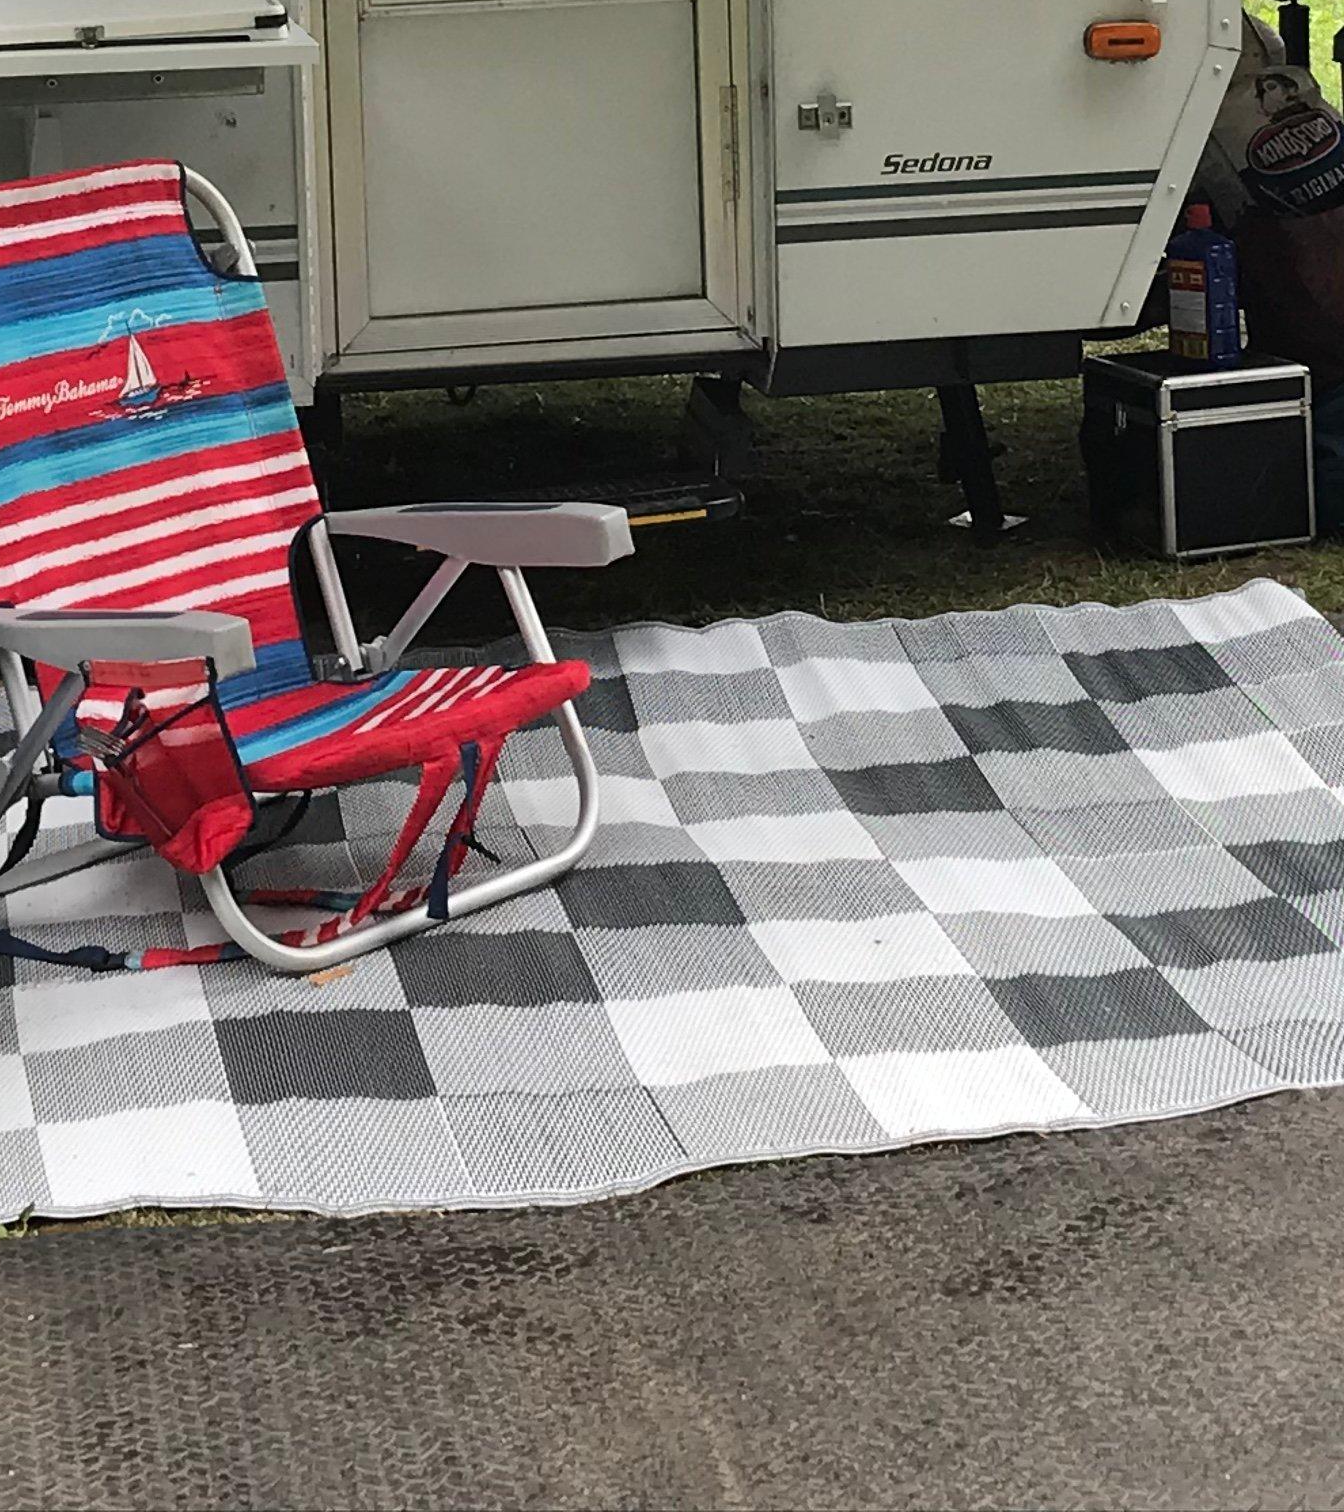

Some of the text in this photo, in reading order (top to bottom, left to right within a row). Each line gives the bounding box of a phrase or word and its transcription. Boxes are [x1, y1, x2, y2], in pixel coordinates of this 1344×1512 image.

[1256, 117, 1333, 167] KINGSFORD
[880, 151, 994, 176] Sedona
[52, 378, 119, 404] Bahama
